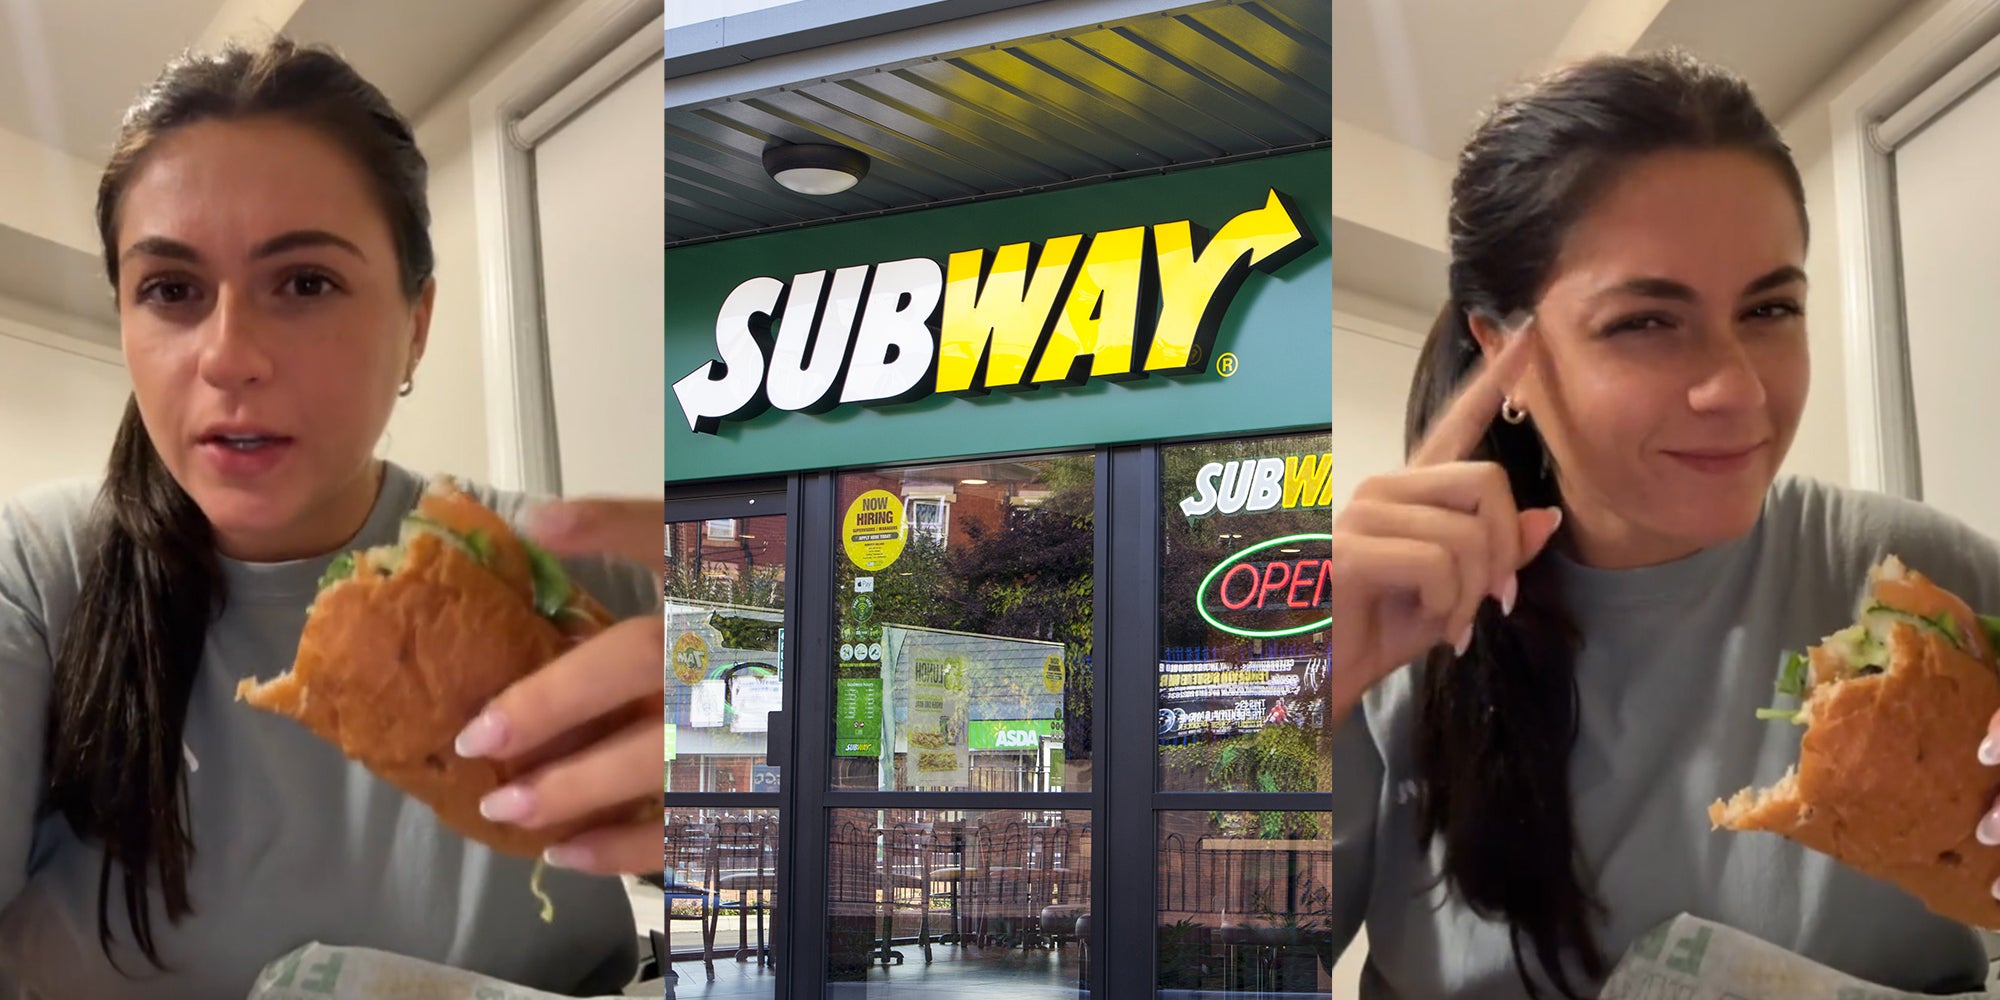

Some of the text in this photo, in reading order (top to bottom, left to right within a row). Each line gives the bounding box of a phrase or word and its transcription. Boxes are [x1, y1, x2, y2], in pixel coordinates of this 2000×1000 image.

[672, 187, 1302, 432] SUBWAY
[862, 497, 888, 511] NOW
[856, 511, 893, 526] HIRING
[995, 729, 1039, 747] ASDA
[845, 743, 872, 751] SUBWAY
